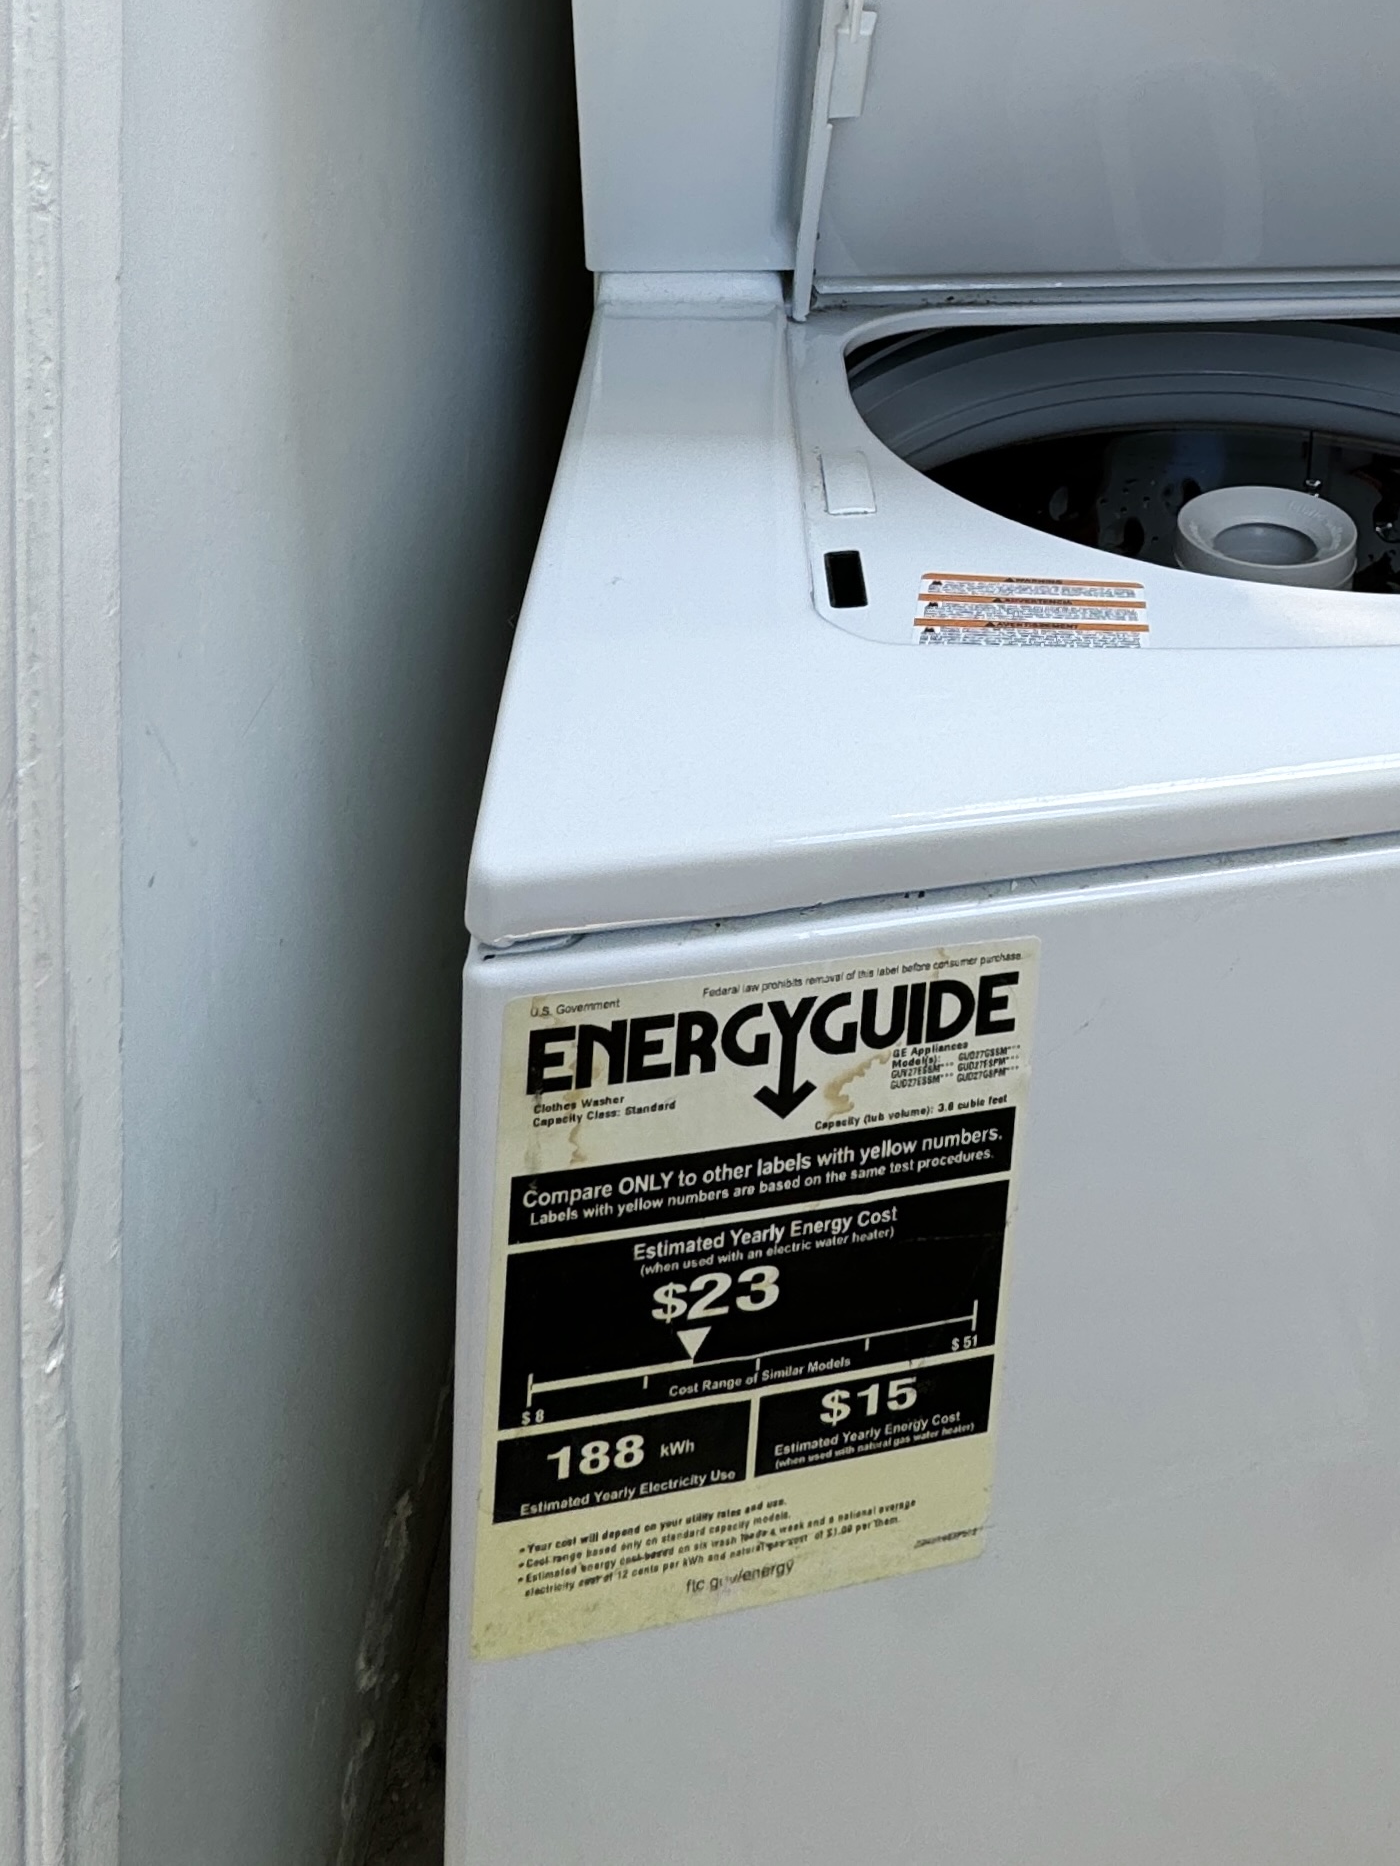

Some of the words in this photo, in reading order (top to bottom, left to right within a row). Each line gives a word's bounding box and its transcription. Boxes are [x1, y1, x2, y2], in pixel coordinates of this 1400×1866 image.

[702, 985, 740, 998] Federal
[741, 981, 760, 994] law
[762, 977, 803, 993] prohibits
[805, 972, 844, 986] removal
[846, 970, 856, 982] of
[857, 968, 874, 979] this
[876, 965, 900, 978] label
[901, 961, 931, 974] before
[933, 956, 978, 970] consumer
[530, 1006, 553, 1017] U.S.
[556, 999, 621, 1015] Government
[526, 971, 1020, 1119] ENERGYGUIDE
[893, 1049, 907, 1058] GE
[911, 1041, 968, 1056] Appliances
[533, 1112, 583, 1128] Capacity
[586, 1109, 621, 1120] Class:
[625, 1100, 676, 1116] Standard
[534, 1102, 576, 1114] Clothes
[581, 1095, 625, 1109] Washer
[523, 1184, 613, 1208] Compare
[618, 1171, 674, 1195] ONLY
[678, 1170, 697, 1187] to
[702, 1164, 752, 1184] other
[757, 1153, 811, 1177] labels
[817, 1146, 854, 1166] with
[859, 1139, 918, 1165] yellow
[921, 1127, 1003, 1151] numbers.
[530, 1210, 578, 1226] Labels
[583, 1204, 613, 1219] with
[617, 1198, 664, 1217] yellow
[667, 1187, 729, 1207] numbers
[733, 1184, 755, 1198] are
[759, 1176, 800, 1194] based
[804, 1175, 822, 1185] on
[825, 1171, 846, 1183] the
[851, 1166, 886, 1179] same
[890, 1159, 914, 1173] test
[917, 1148, 994, 1172] procedures.
[633, 1232, 725, 1261] Estimated
[730, 1224, 785, 1245] Yearly
[790, 1216, 852, 1237] Energy
[857, 1206, 898, 1228] Cost
[640, 1261, 679, 1277] (when
[683, 1255, 714, 1269] used
[718, 1249, 744, 1263] with
[747, 1248, 763, 1259] an
[766, 1241, 812, 1257] electric
[815, 1234, 849, 1250] water
[851, 1227, 895, 1244] heater)
[652, 1265, 780, 1323] $23
[669, 1384, 698, 1397] Cost
[702, 1377, 742, 1392] Range
[745, 1372, 758, 1385] of
[761, 1365, 803, 1382] Similar
[807, 1357, 851, 1373] Models
[820, 1376, 917, 1426] $15
[774, 1436, 838, 1456] Estimated
[842, 1428, 881, 1444] Yearly
[884, 1418, 929, 1434] Energy
[932, 1411, 961, 1426] Cost
[775, 1454, 806, 1469] (when
[808, 1449, 833, 1461] used
[835, 1445, 855, 1456] with
[857, 1437, 892, 1452] natural
[893, 1435, 911, 1447] gas
[913, 1429, 939, 1442] water
[941, 1422, 975, 1437] heater)
[547, 1434, 644, 1480] 188
[660, 1439, 695, 1458] kWh
[520, 1492, 590, 1516] Estimated
[594, 1486, 636, 1504] Yearly
[639, 1474, 707, 1496] Electricity
[710, 1469, 736, 1482] Use
[686, 1559, 794, 1593] ftcgv/energy
